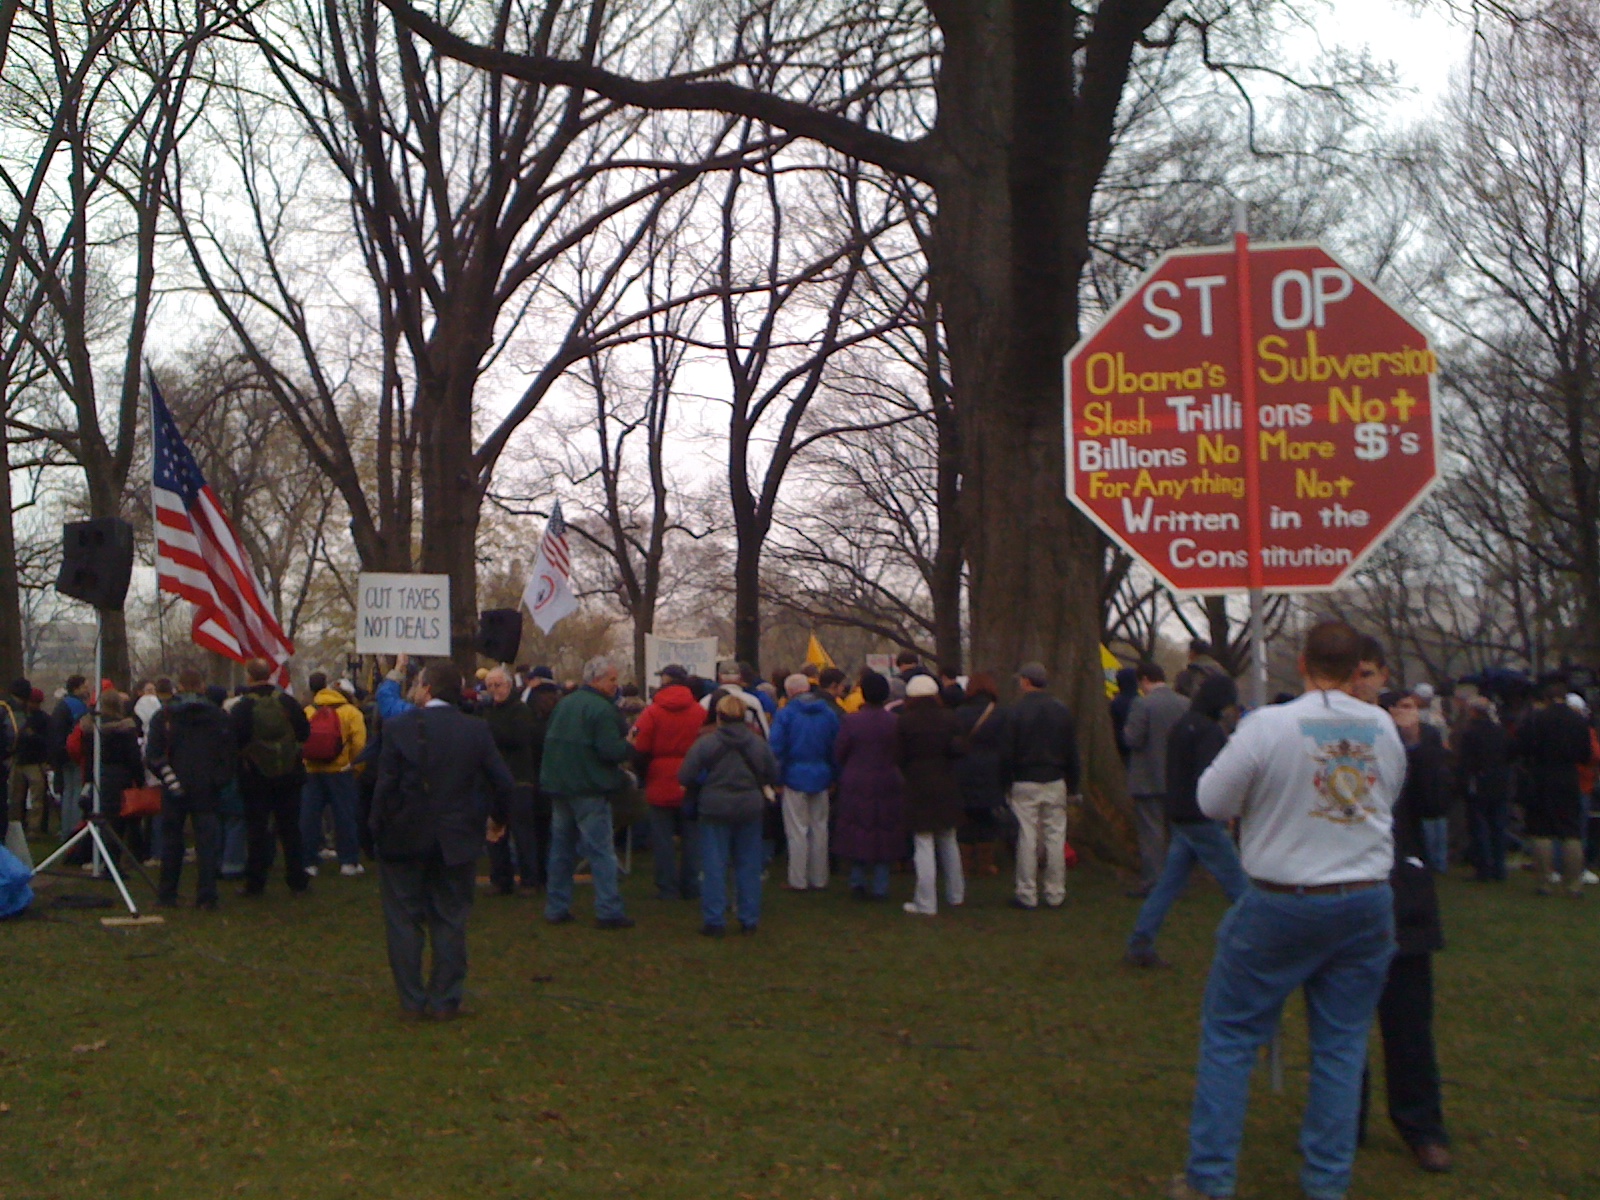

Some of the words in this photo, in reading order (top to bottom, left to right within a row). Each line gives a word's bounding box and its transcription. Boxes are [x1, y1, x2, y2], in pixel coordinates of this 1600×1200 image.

[1257, 330, 1436, 384] Subversion
[1083, 396, 1153, 436] Slash
[1328, 385, 1416, 423] Not
[1078, 438, 1187, 472] Billions
[1197, 433, 1241, 464] No
[1259, 429, 1336, 461] More
[1089, 471, 1131, 499] For
[1132, 468, 1245, 500] Anything
[1295, 467, 1355, 498] Not
[1121, 497, 1240, 533] Written
[1270, 505, 1302, 529] in
[1318, 502, 1370, 528] the
[365, 586, 392, 609] CUT
[398, 586, 440, 610] TAXES
[364, 615, 392, 638] NOT
[396, 616, 440, 639] DEALS
